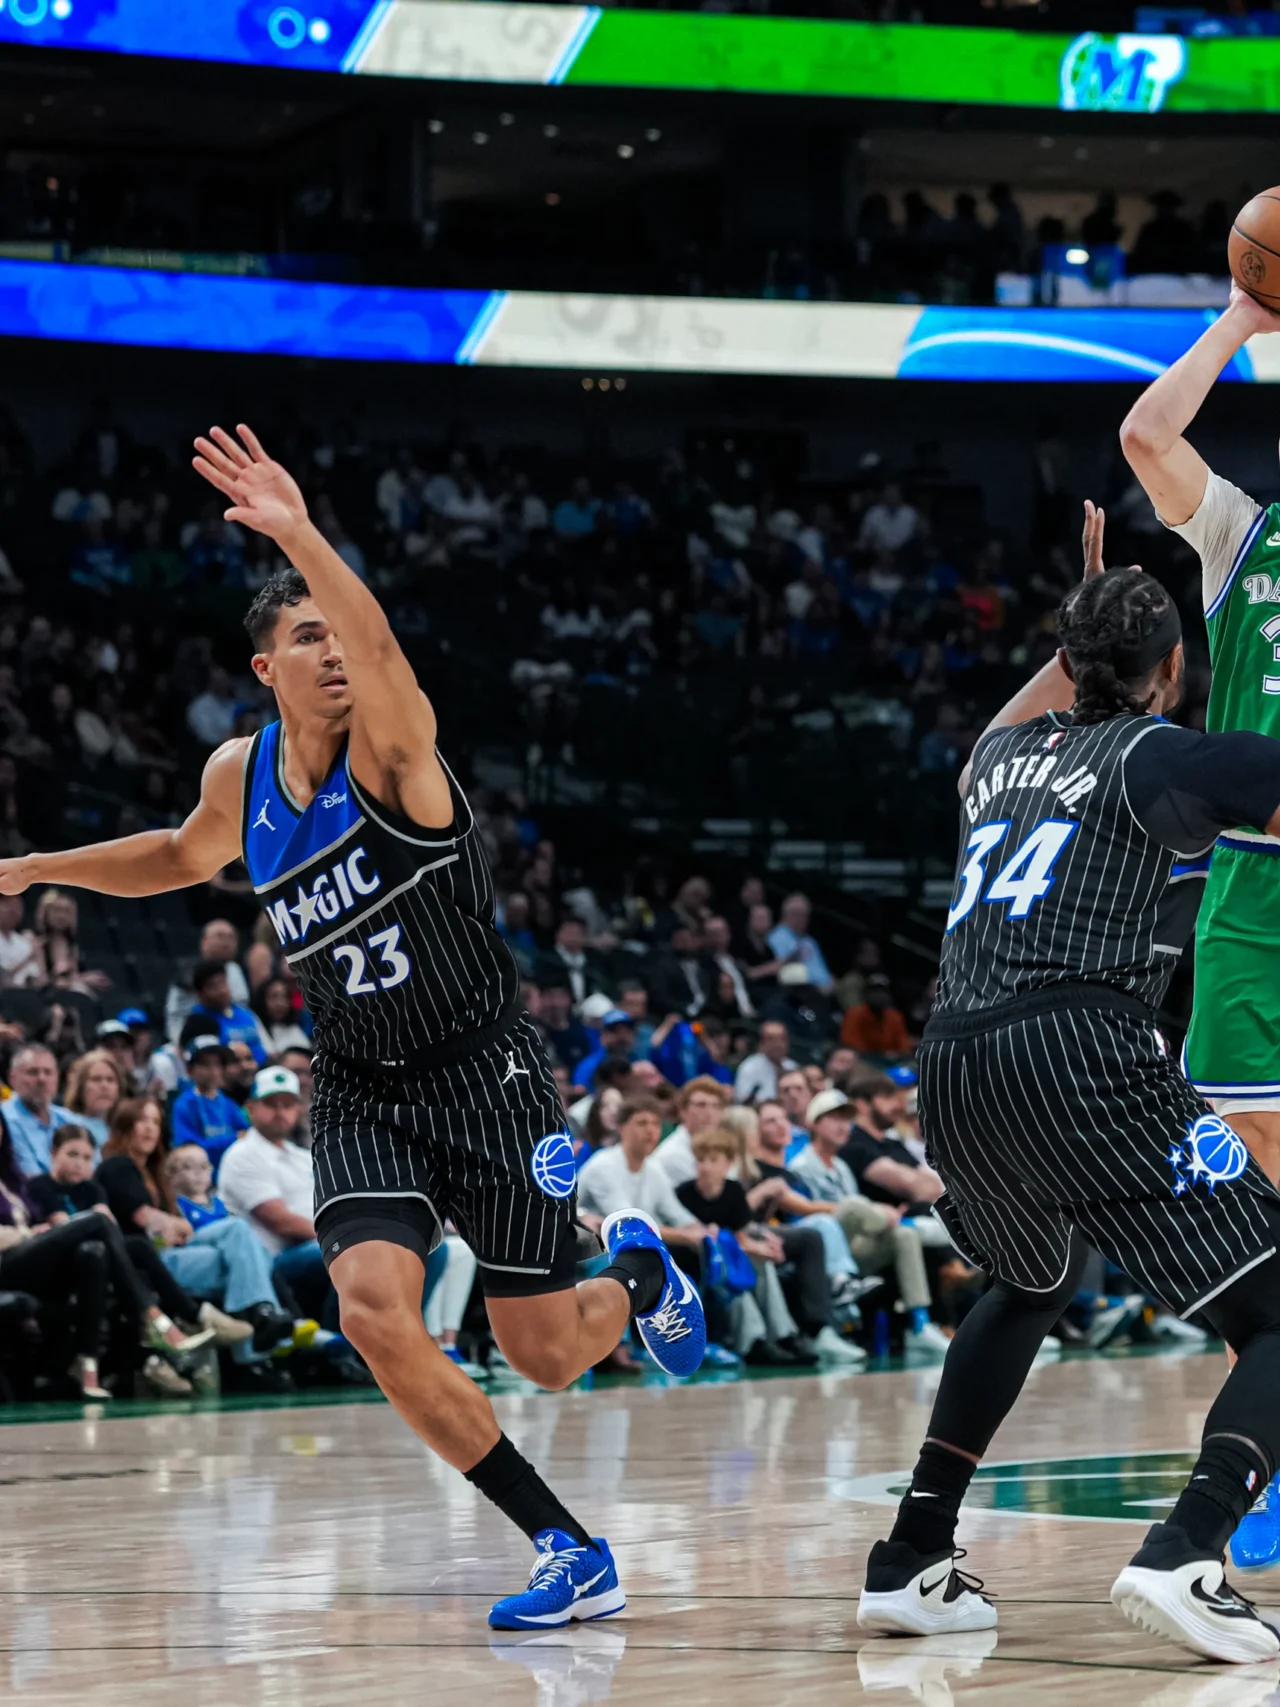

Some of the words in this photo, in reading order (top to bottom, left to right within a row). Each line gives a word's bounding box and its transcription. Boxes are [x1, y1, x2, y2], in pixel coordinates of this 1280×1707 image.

[965, 754, 1058, 823] CARTER
[1051, 765, 1099, 813] JR.
[946, 817, 1080, 935] 34
[333, 924, 411, 996] 23
